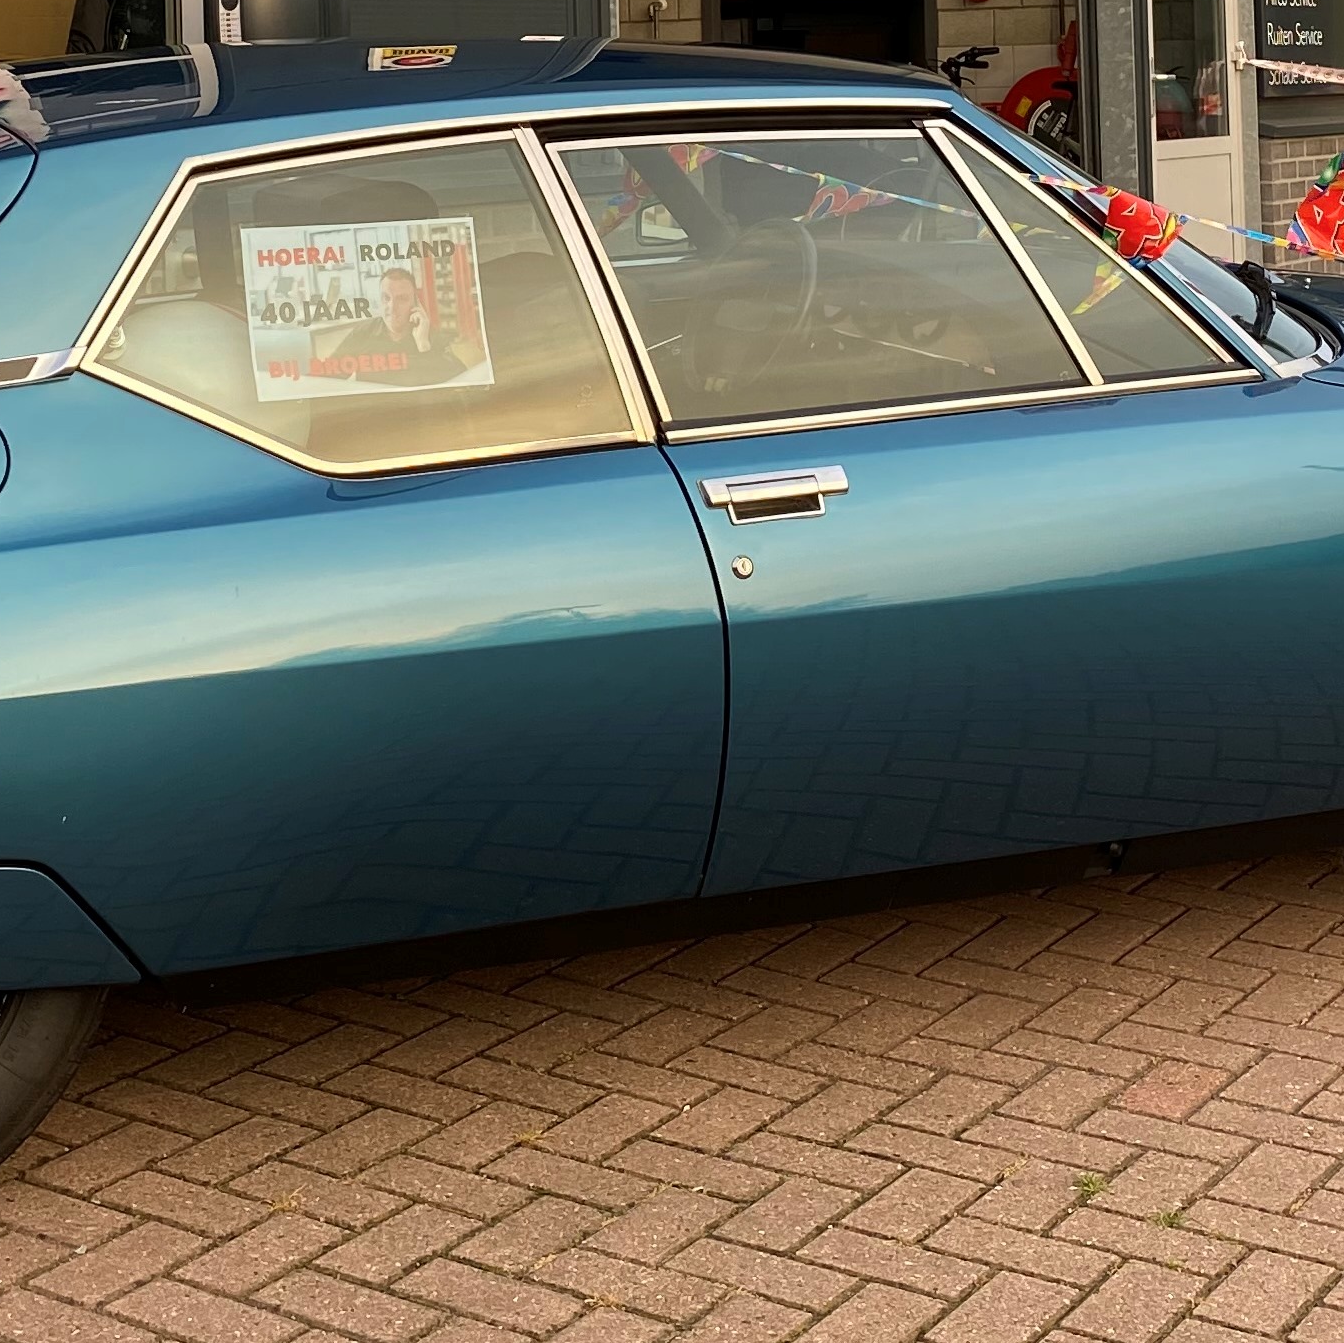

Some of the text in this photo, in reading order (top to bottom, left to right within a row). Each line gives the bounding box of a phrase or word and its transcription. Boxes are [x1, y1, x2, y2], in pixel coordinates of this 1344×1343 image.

[1267, 22, 1323, 46] Ruiten Service
[257, 239, 455, 267] HOERA! ROLAND
[261, 297, 373, 327] 40 JAAR
[309, 352, 408, 377] BROERE!
